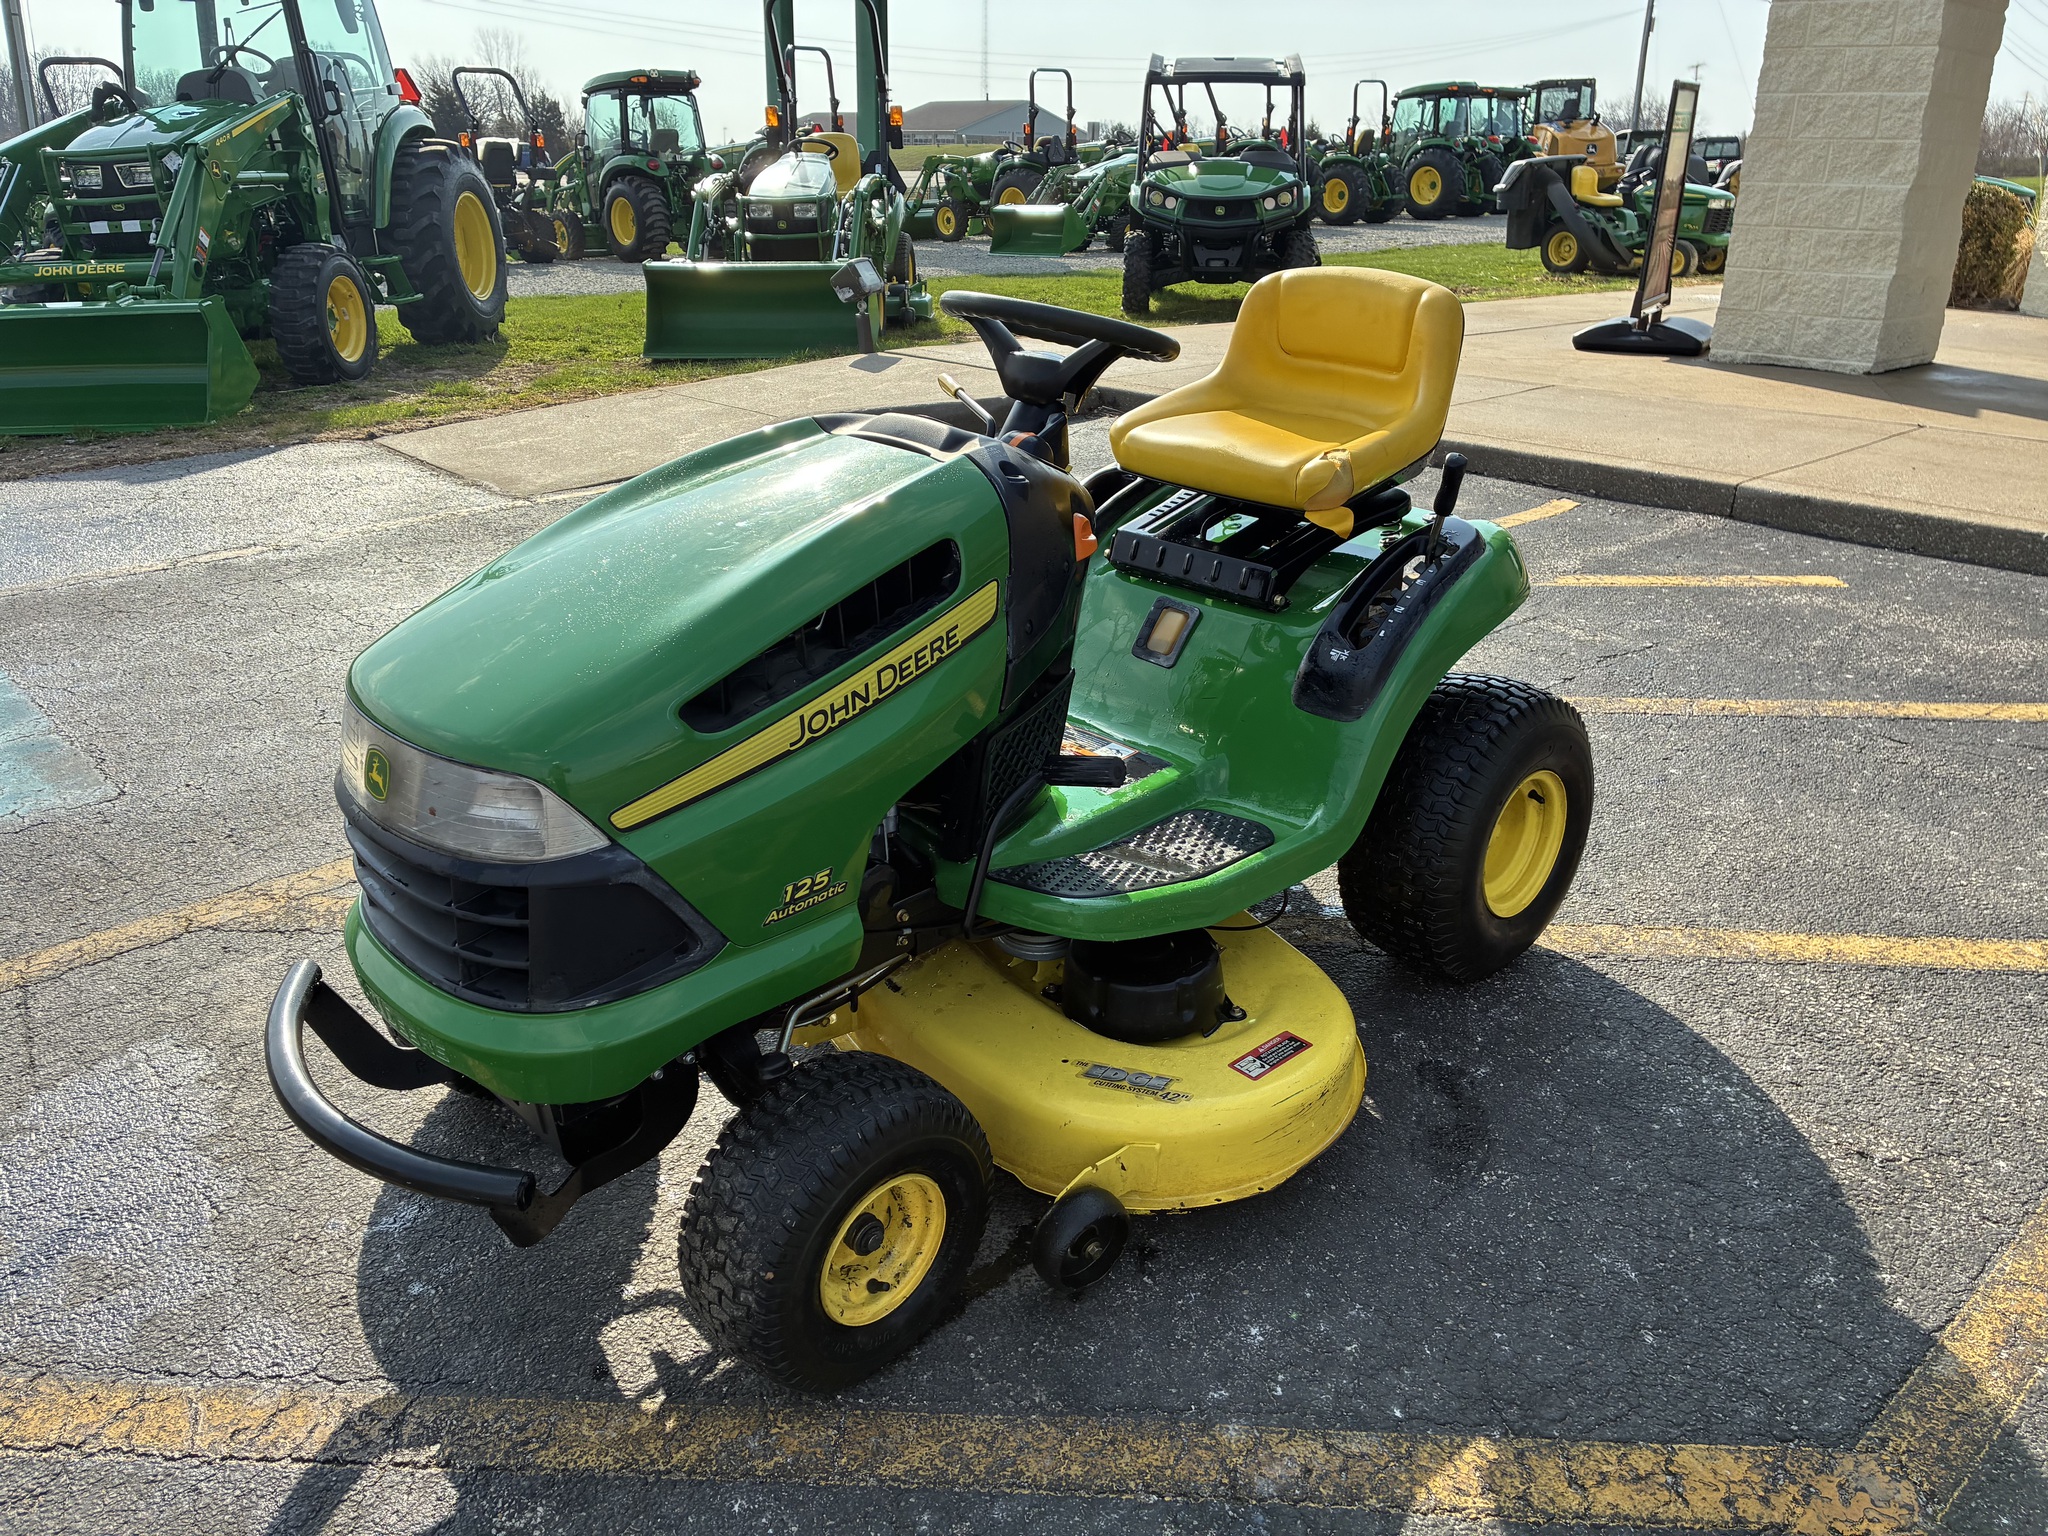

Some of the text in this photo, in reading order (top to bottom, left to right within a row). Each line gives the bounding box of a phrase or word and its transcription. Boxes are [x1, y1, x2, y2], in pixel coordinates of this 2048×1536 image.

[34, 264, 126, 277] JOHN DEERE
[789, 623, 960, 748] JOHN DEERE
[784, 868, 831, 903] 125
[764, 882, 847, 925] Automatic
[1081, 1064, 1173, 1091] EDGE
[1093, 1080, 1190, 1103] CUTTING SYSTEM 42"
